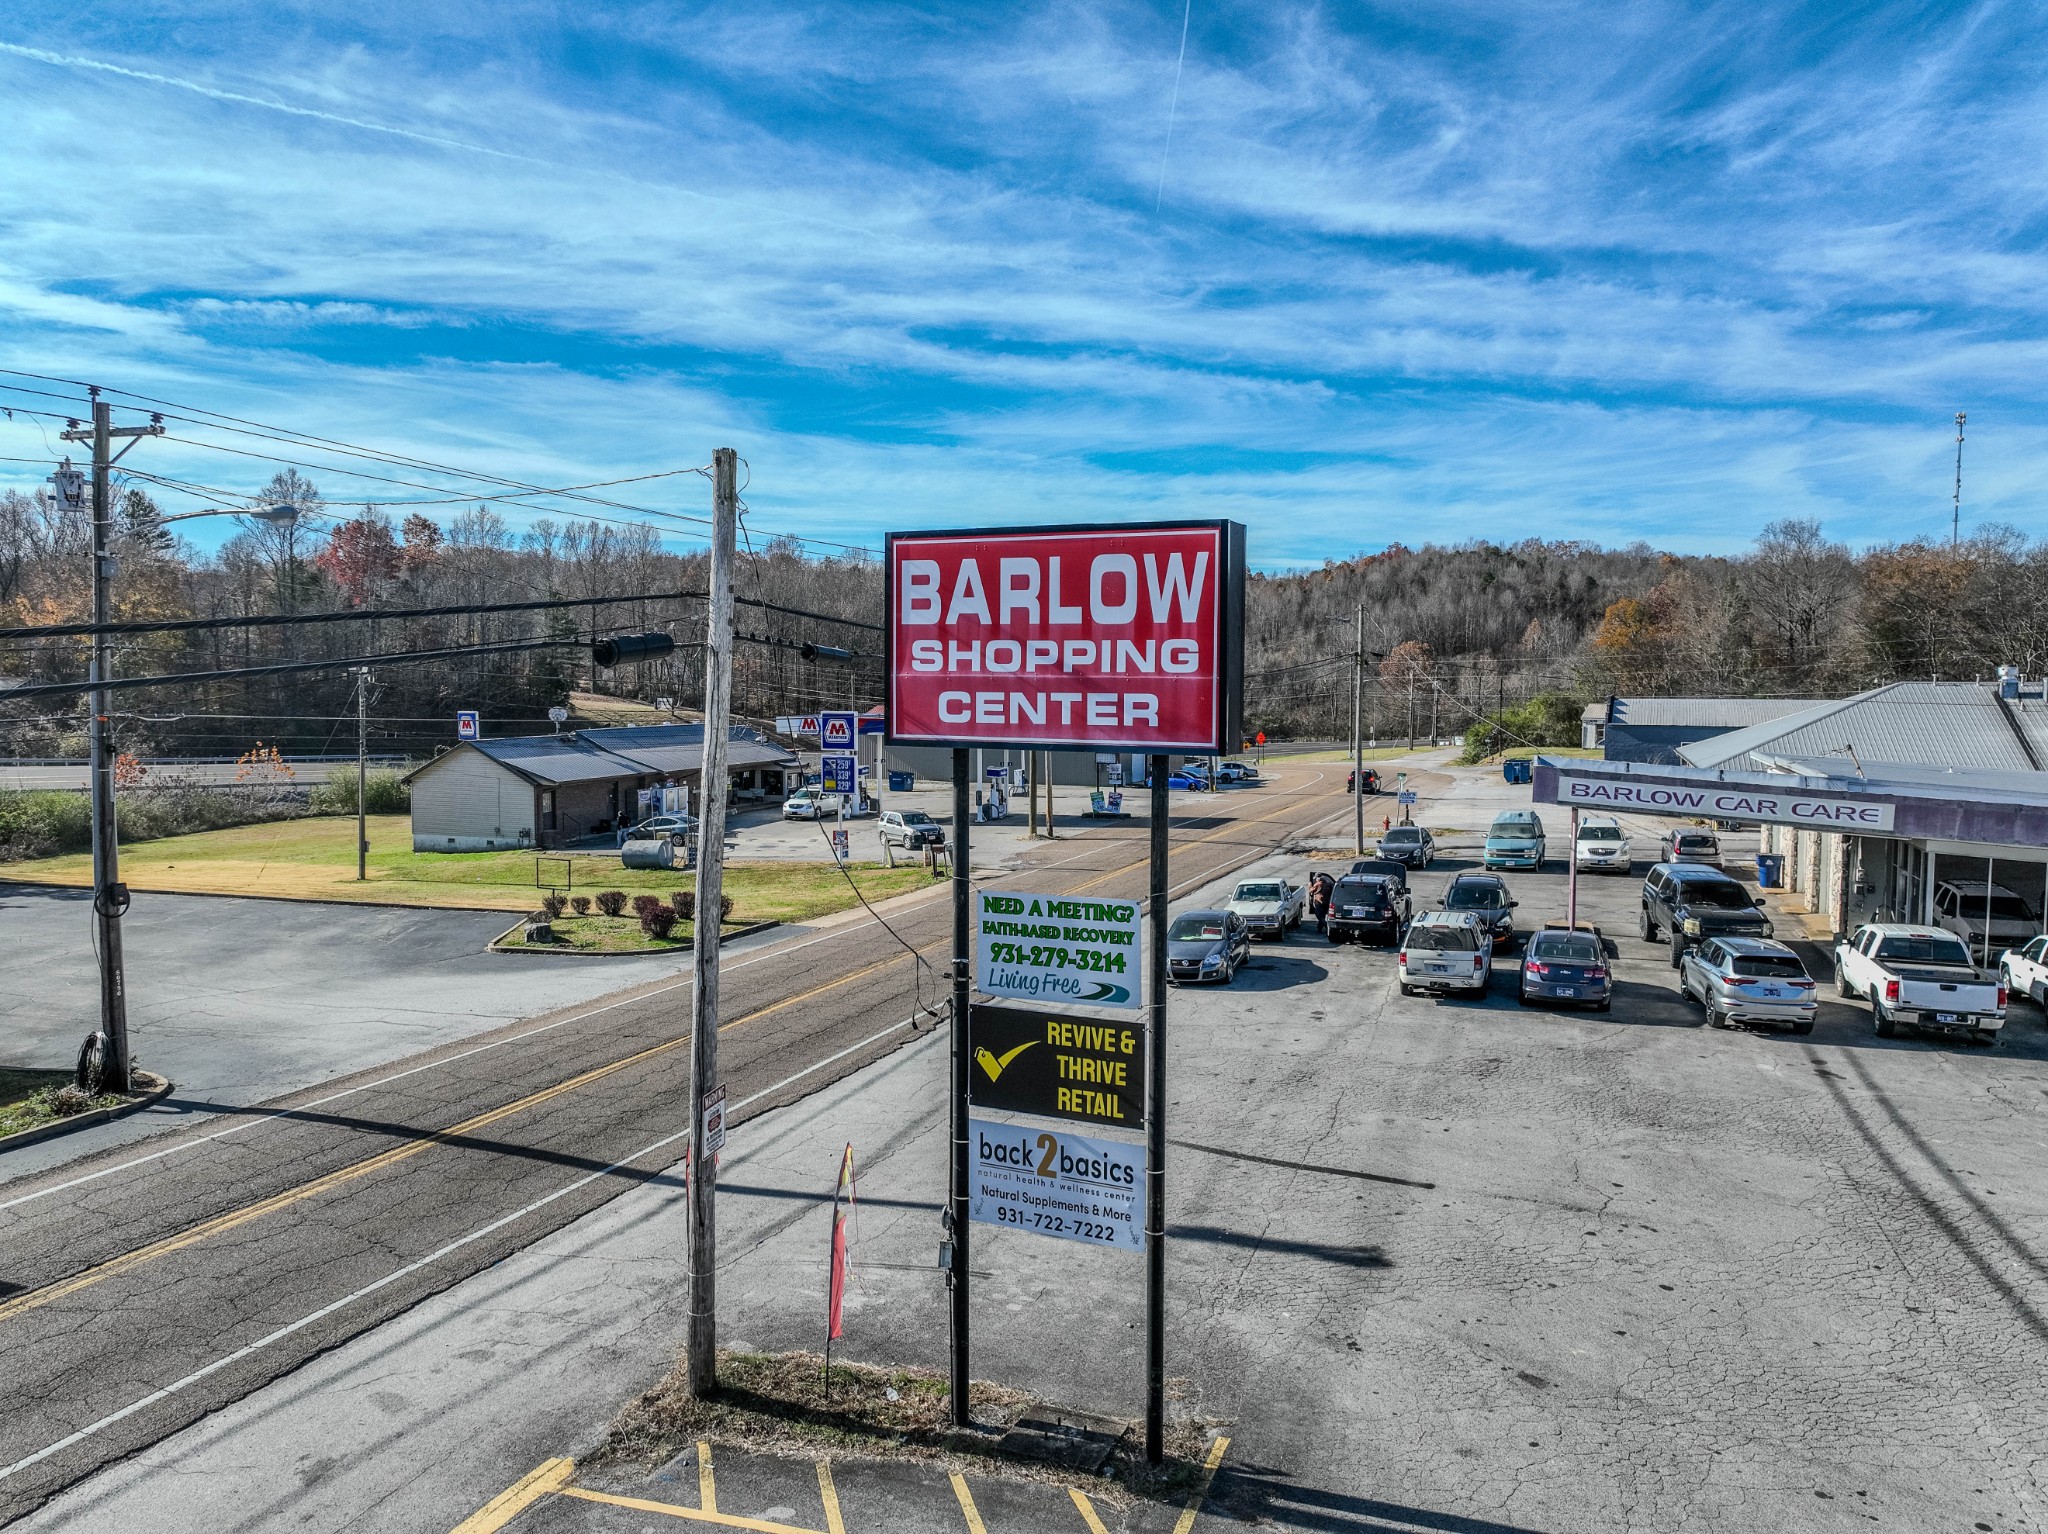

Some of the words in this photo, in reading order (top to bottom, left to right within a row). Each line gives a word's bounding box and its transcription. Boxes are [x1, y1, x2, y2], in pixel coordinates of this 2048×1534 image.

[901, 551, 1209, 625] BARLOW
[911, 639, 1199, 673] SHOPPING
[938, 691, 1159, 727] CENTER
[1571, 782, 1705, 808] BARLOW
[1715, 796, 1778, 815] CAR
[1791, 803, 1879, 823] CARE
[983, 896, 1024, 915] NEED
[1028, 900, 1043, 918] A
[1047, 900, 1134, 923] MEETING?
[983, 921, 1061, 940] FAITH-BASED
[1063, 927, 1135, 945] RECOVERY
[990, 942, 1126, 973] 931-279-3214
[988, 968, 1039, 995] Living
[1042, 972, 1081, 994] Free
[1047, 1021, 1116, 1052] REVIVE
[1121, 1030, 1135, 1054] &
[1056, 1055, 1126, 1086] THRIVE
[1058, 1087, 1124, 1118] RETAIL
[977, 1169, 1012, 1181] natural
[1016, 1174, 1046, 1187] health
[1060, 1182, 1100, 1197] wellness
[1104, 1191, 1135, 1203] center
[981, 1184, 1020, 1202] Natural
[1022, 1191, 1089, 1214] Supplements
[1092, 1204, 1100, 1216] &
[1103, 1206, 1132, 1222] More
[997, 1206, 1114, 1242] 931-722-7222
